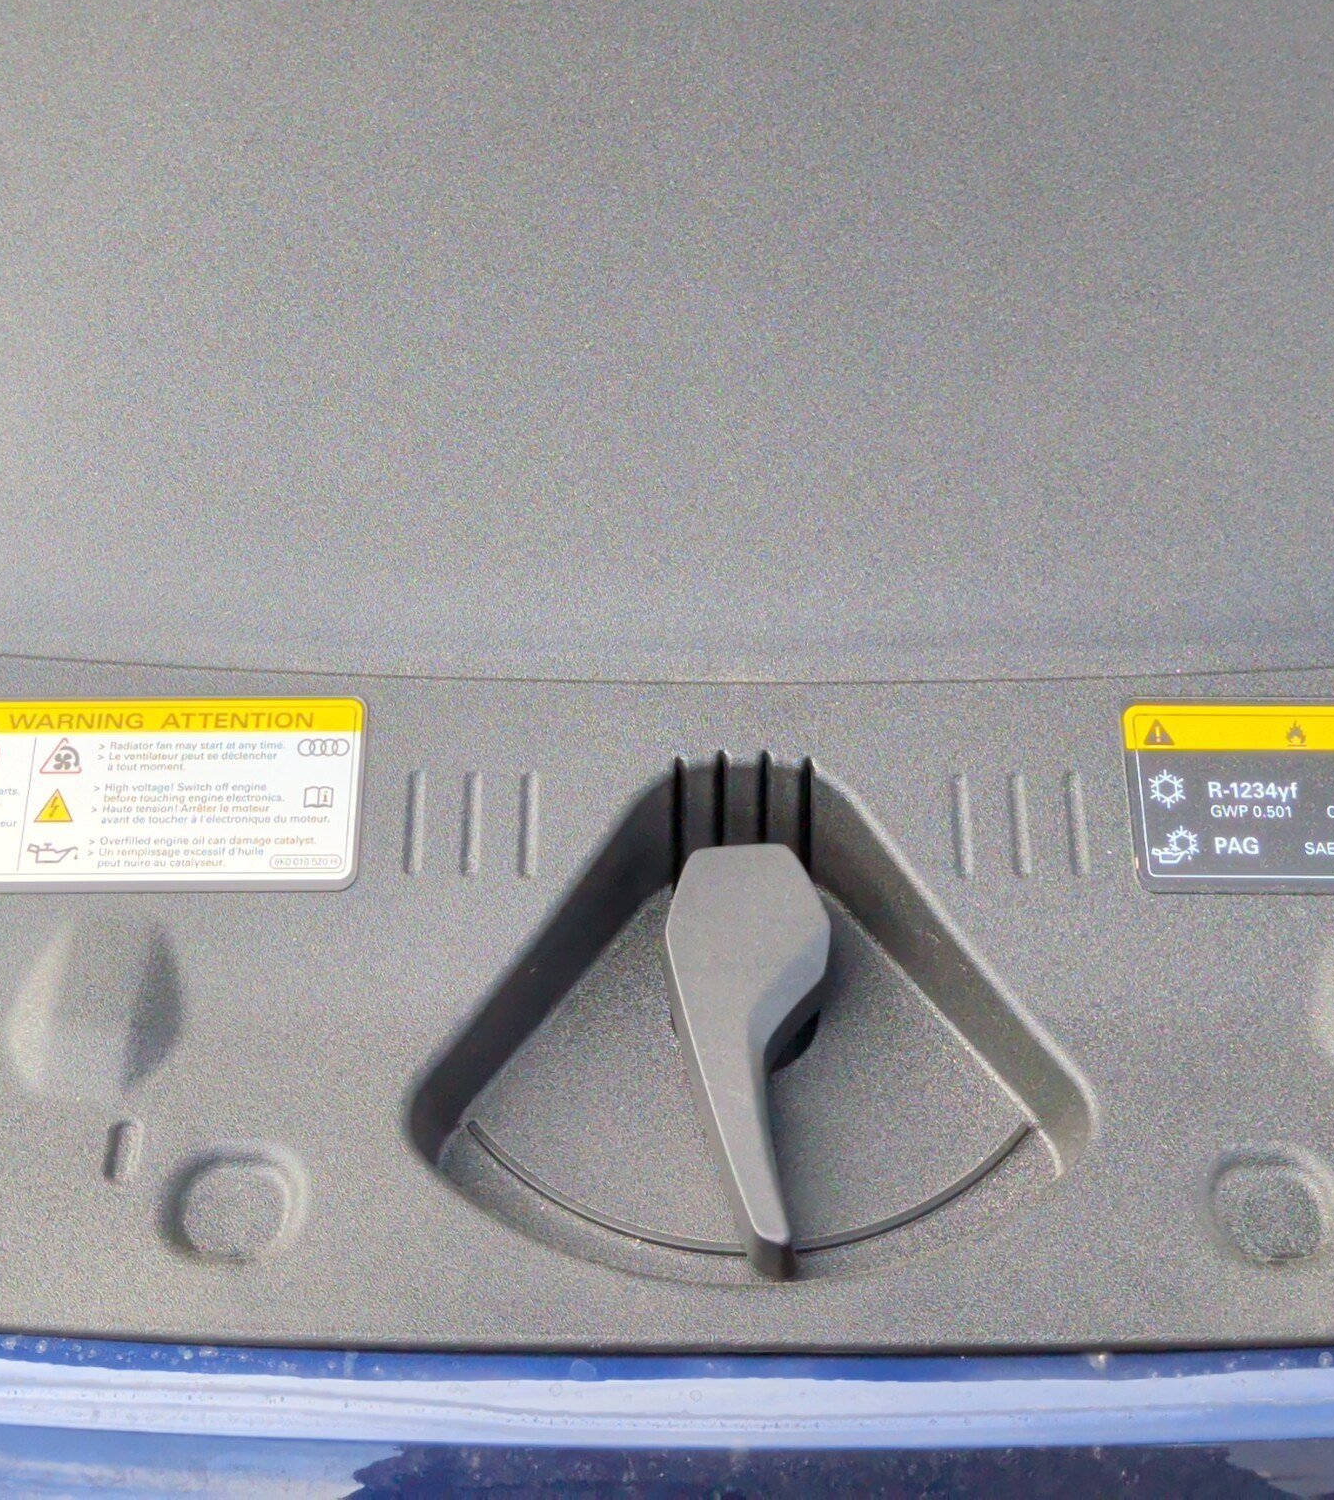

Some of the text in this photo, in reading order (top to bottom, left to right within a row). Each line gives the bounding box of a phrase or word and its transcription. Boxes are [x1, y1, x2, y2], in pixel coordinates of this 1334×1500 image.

[10, 712, 314, 729] WARNING ATTENTION
[110, 742, 153, 750] Radiator
[157, 742, 172, 750] fan
[176, 743, 197, 752] may
[200, 742, 223, 750] start
[239, 743, 257, 751] any
[124, 752, 178, 760] ventilateur
[181, 753, 204, 762] peut
[117, 763, 137, 771] tout
[140, 763, 185, 771] moment.
[105, 783, 267, 794] High voltage! Switch off engine
[1208, 781, 1298, 803] R-1234yf
[104, 794, 285, 804] before touching engine electronics.
[103, 804, 132, 813] Haute
[136, 804, 177, 813] tension!
[220, 804, 229, 812] le
[1211, 805, 1248, 818] GWP
[1253, 806, 1291, 818] 0.501
[101, 816, 129, 824] avant
[133, 815, 145, 823] de
[149, 815, 188, 823] toucher
[274, 814, 286, 823] du
[100, 836, 151, 845] Overfilled
[154, 838, 189, 847] engine
[192, 836, 205, 845] oil
[229, 836, 271, 846] damage
[274, 836, 316, 846] catalyst.
[1214, 837, 1259, 855] PAG
[99, 848, 114, 856] Un
[117, 847, 180, 857] remplissage
[184, 847, 226, 855] excessif
[98, 859, 120, 868] peut
[124, 858, 150, 867] nuire
